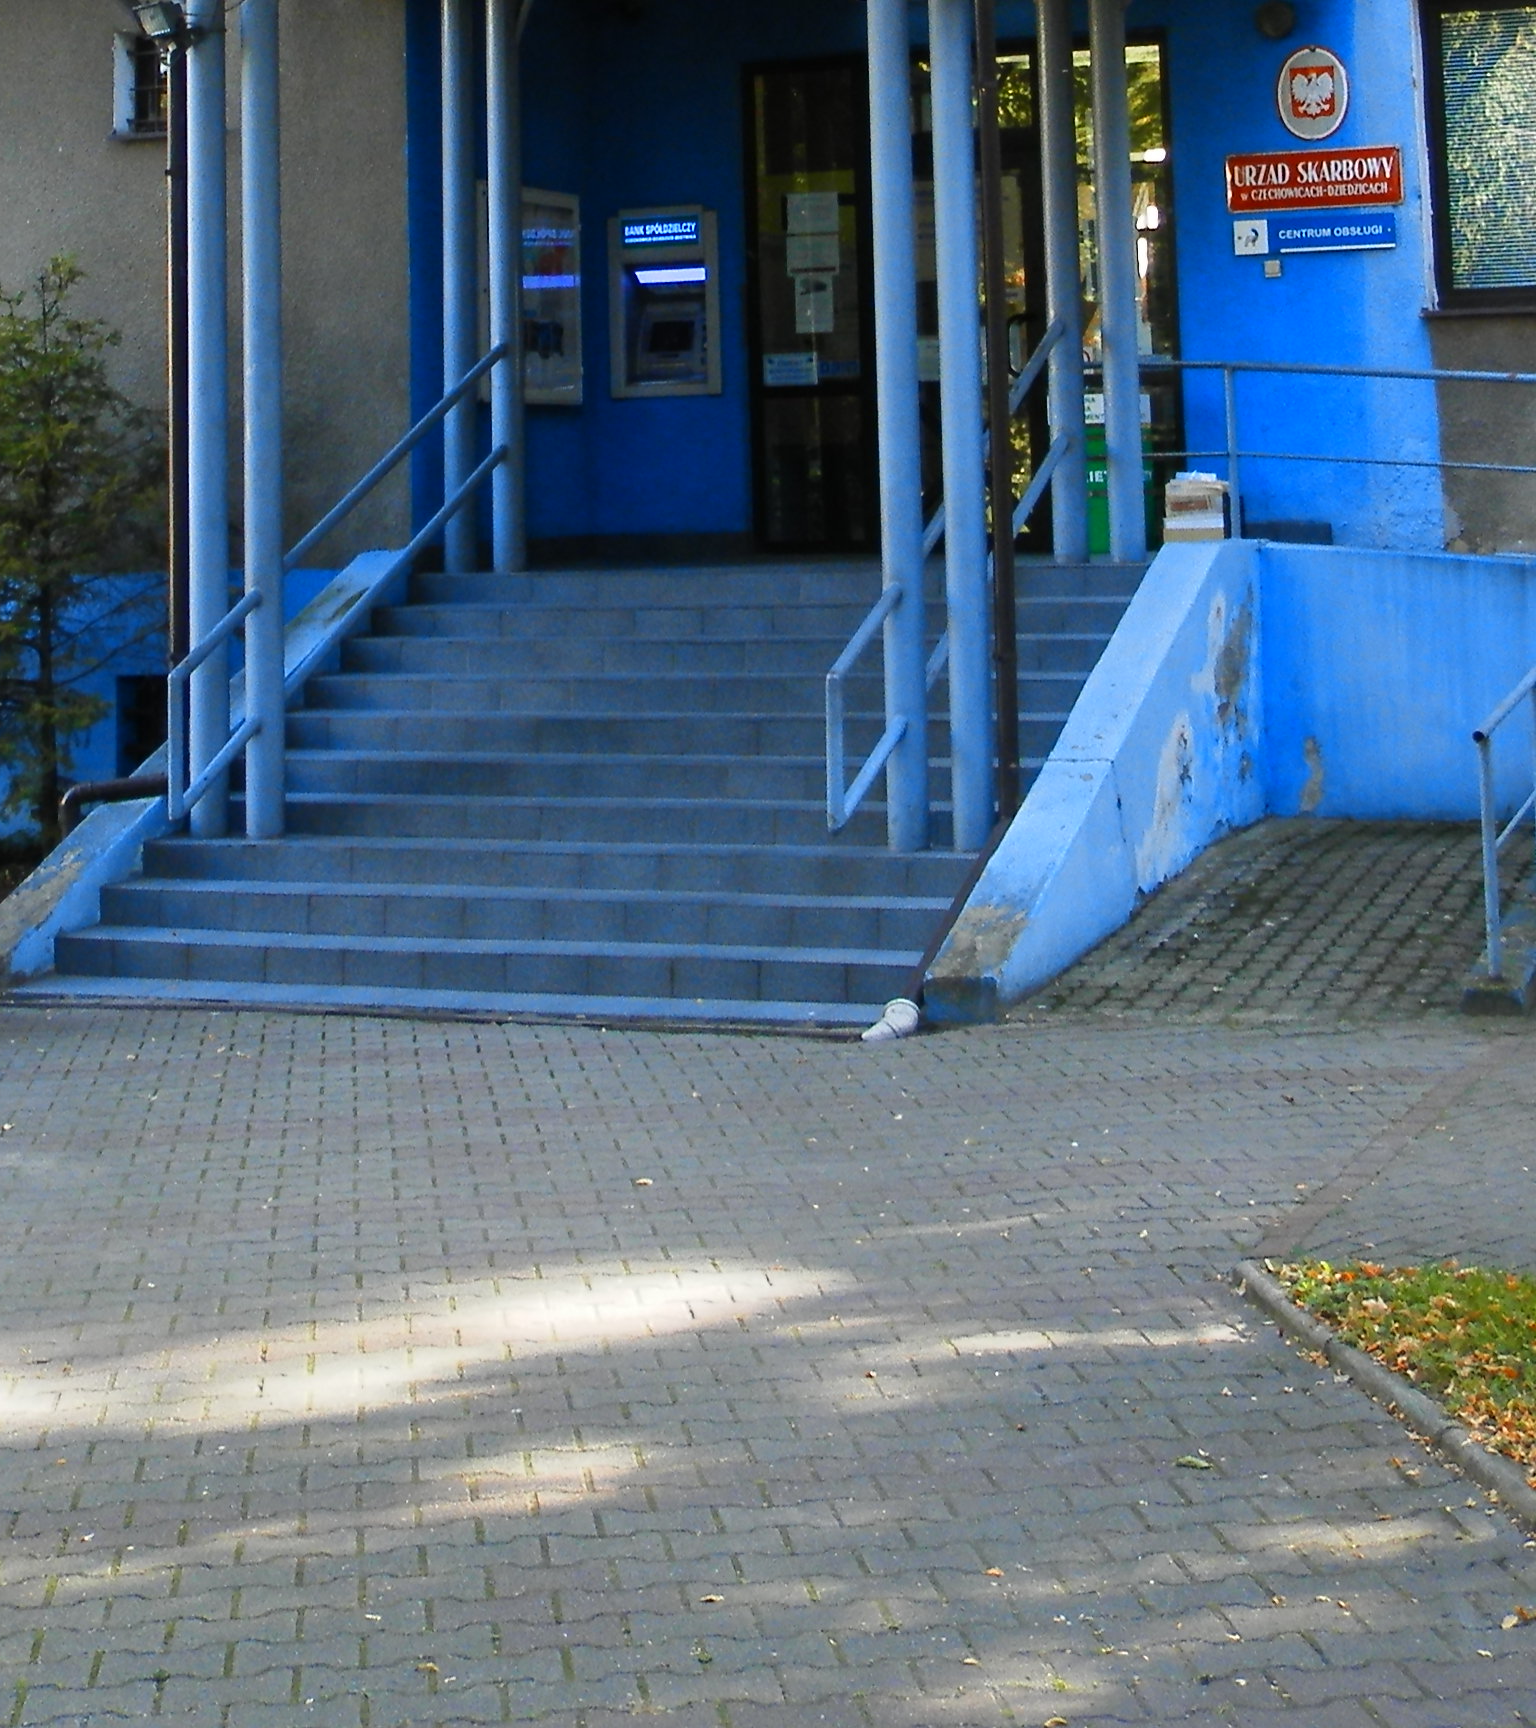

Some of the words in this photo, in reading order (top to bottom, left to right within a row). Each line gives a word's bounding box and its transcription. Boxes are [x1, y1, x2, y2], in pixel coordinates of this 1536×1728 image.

[1296, 156, 1394, 184] SKARBOWY
[1278, 227, 1332, 240] CENTRUM
[1333, 224, 1383, 238] OBSŁUGI
